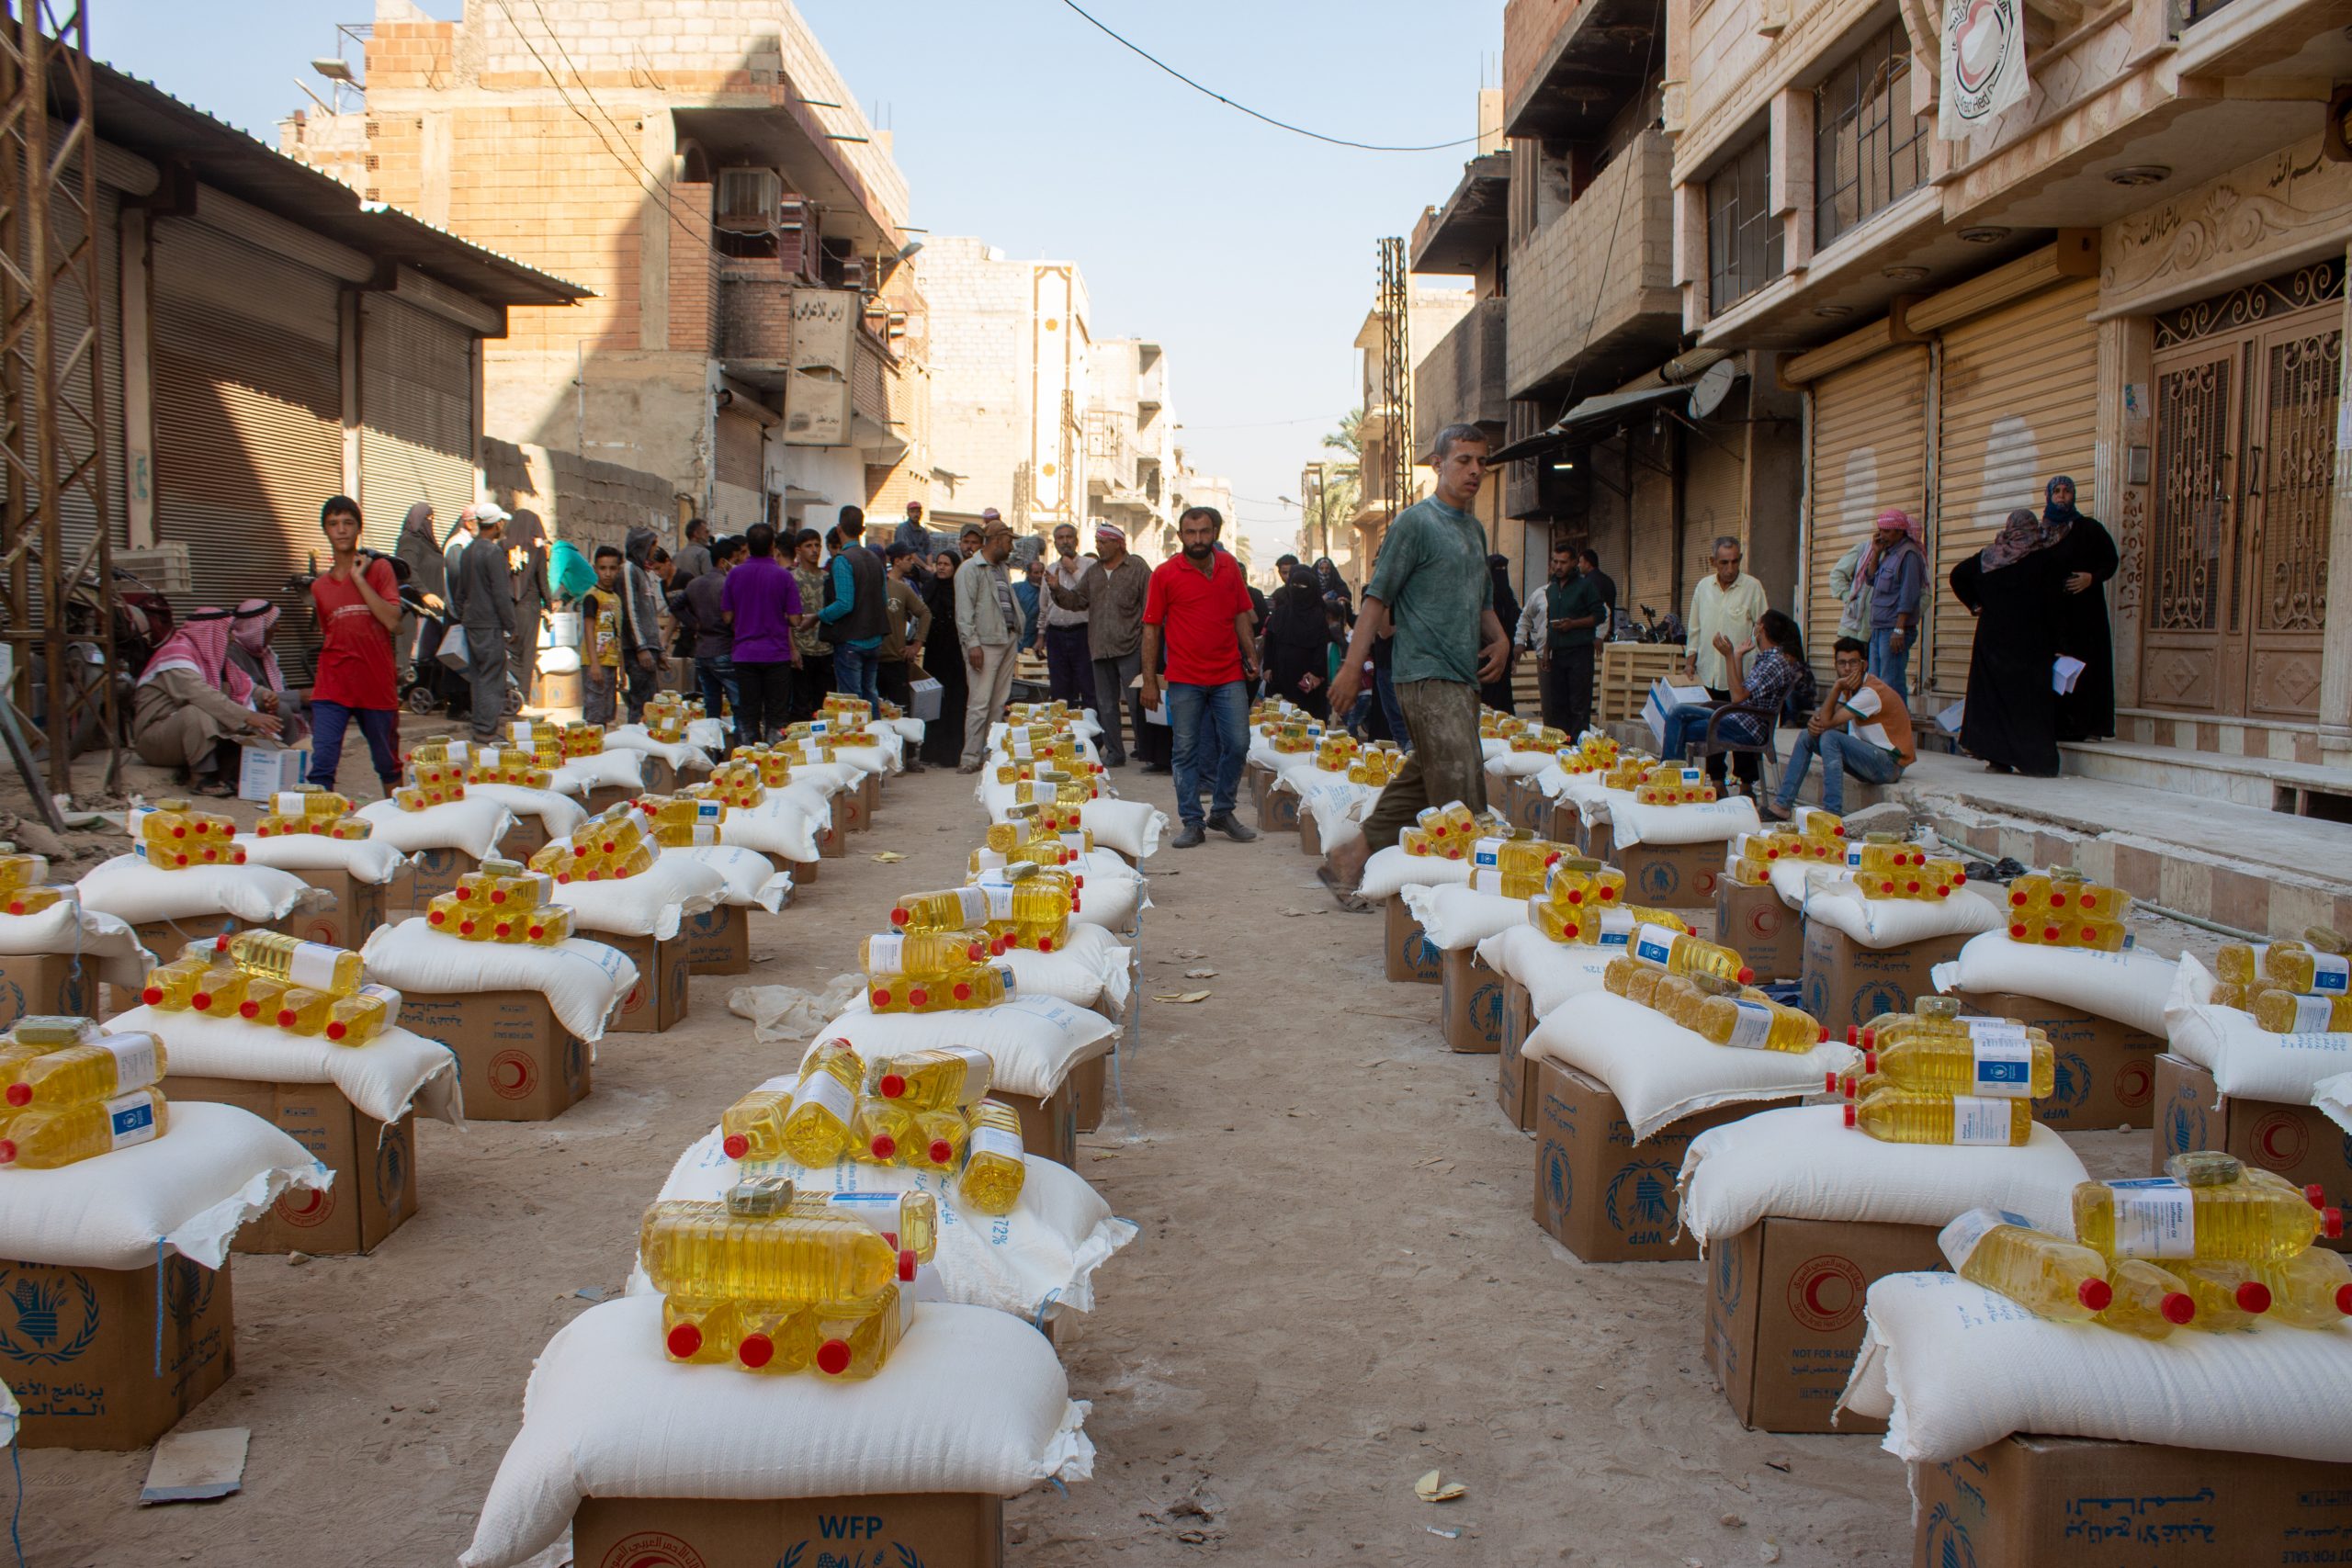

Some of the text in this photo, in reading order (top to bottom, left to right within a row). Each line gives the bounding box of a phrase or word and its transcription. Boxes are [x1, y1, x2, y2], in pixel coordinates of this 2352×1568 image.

[991, 1220, 1010, 1247] 72%
[1628, 1231, 1662, 1246] WFP
[1792, 1348, 1855, 1359] NOT FOR SALE
[51, 1382, 104, 1403] برنامج
[19, 1403, 105, 1416] العالم
[2065, 1487, 2216, 1516] العالمي
[818, 1514, 884, 1540] WFP
[2065, 1517, 2216, 1544] برنامج الأغذية
[628, 1536, 662, 1553] العربي
[2281, 1549, 2352, 1563] OT FOR SALE
